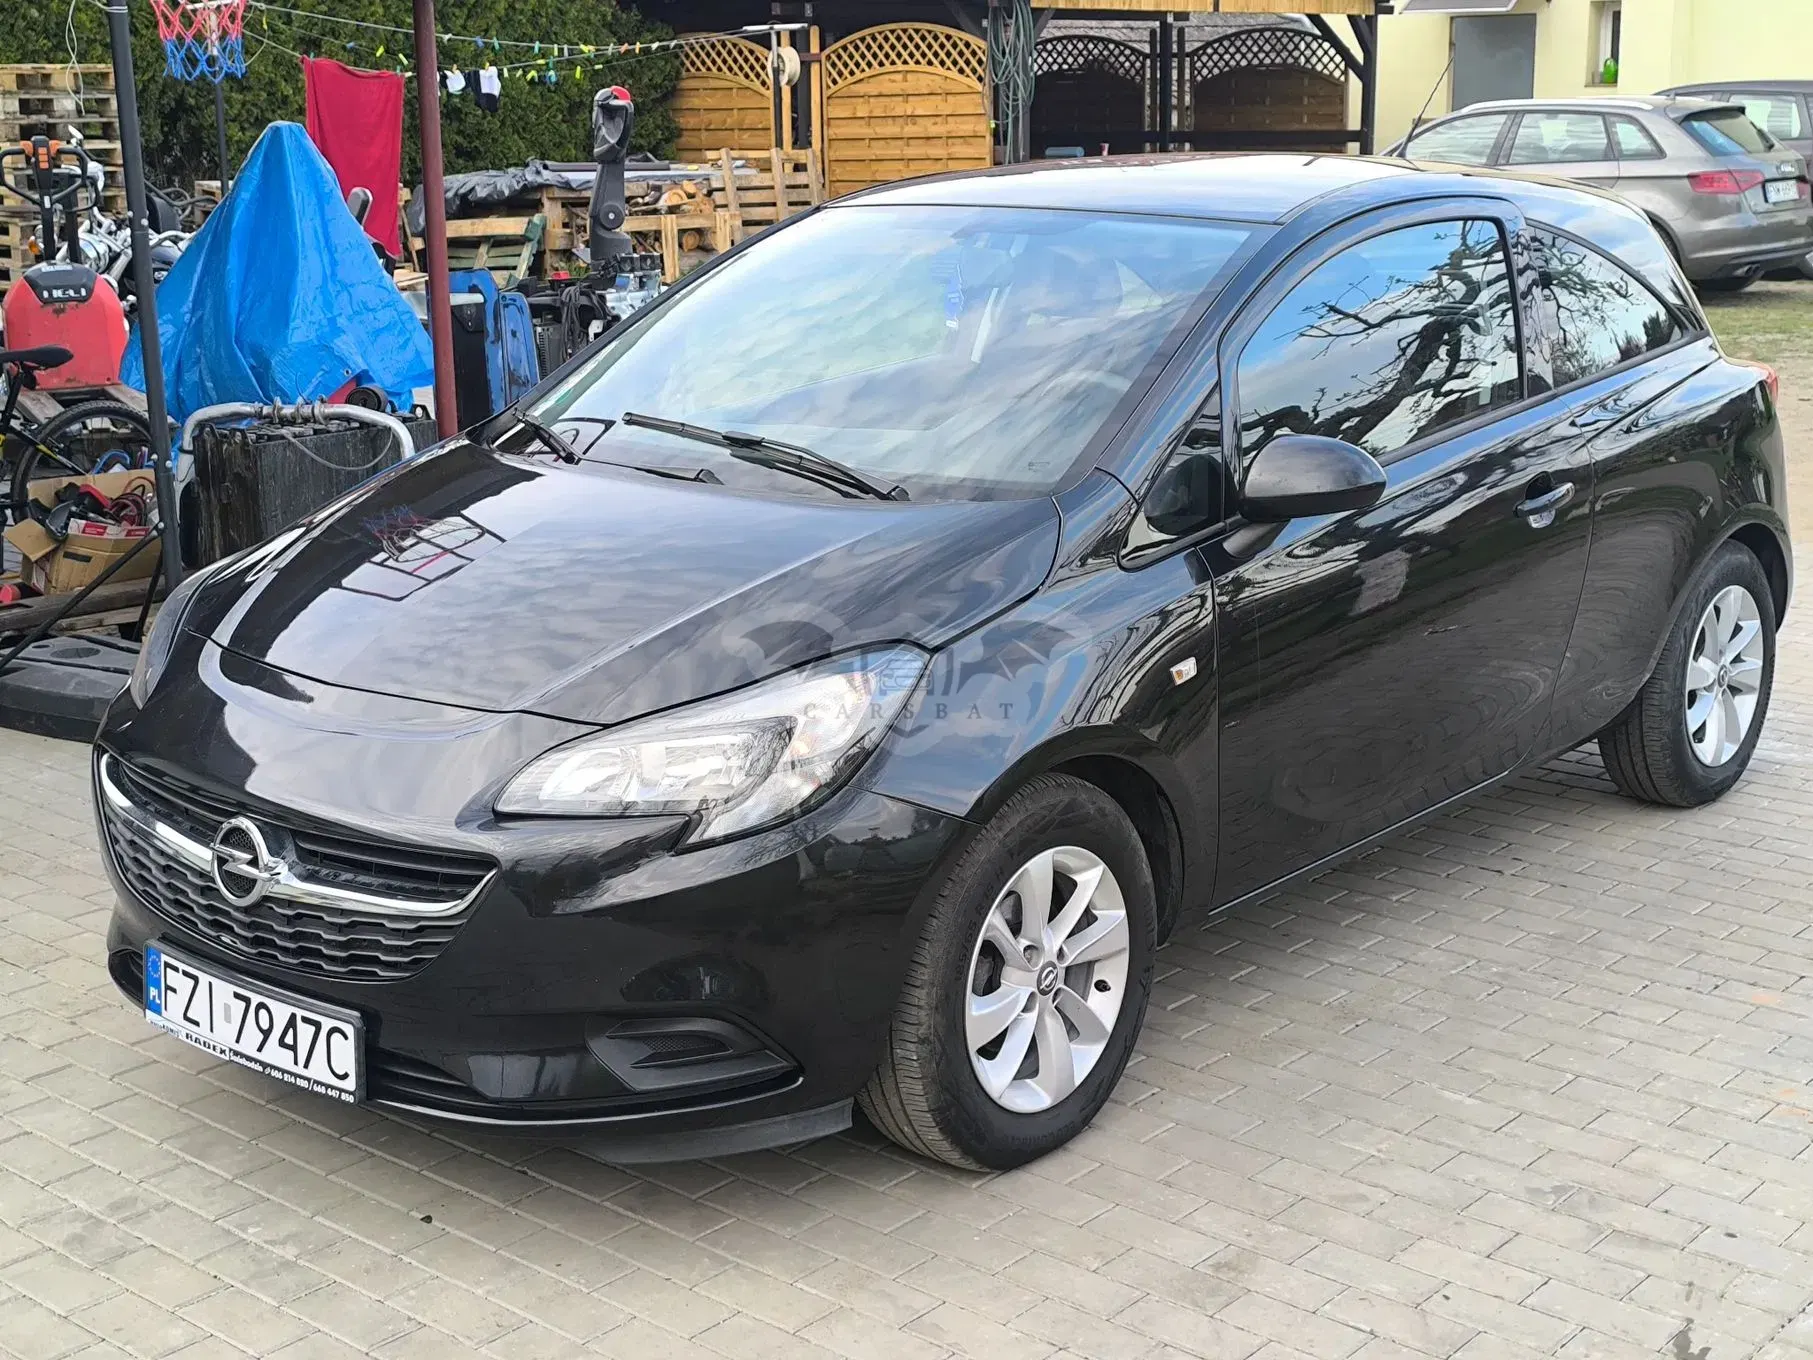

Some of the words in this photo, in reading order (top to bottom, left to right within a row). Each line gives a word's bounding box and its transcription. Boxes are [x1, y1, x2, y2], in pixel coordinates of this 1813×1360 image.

[150, 986, 161, 1004] PL
[163, 960, 214, 1034] FZI
[233, 991, 349, 1081] 7947C
[185, 1032, 227, 1056] RADEK
